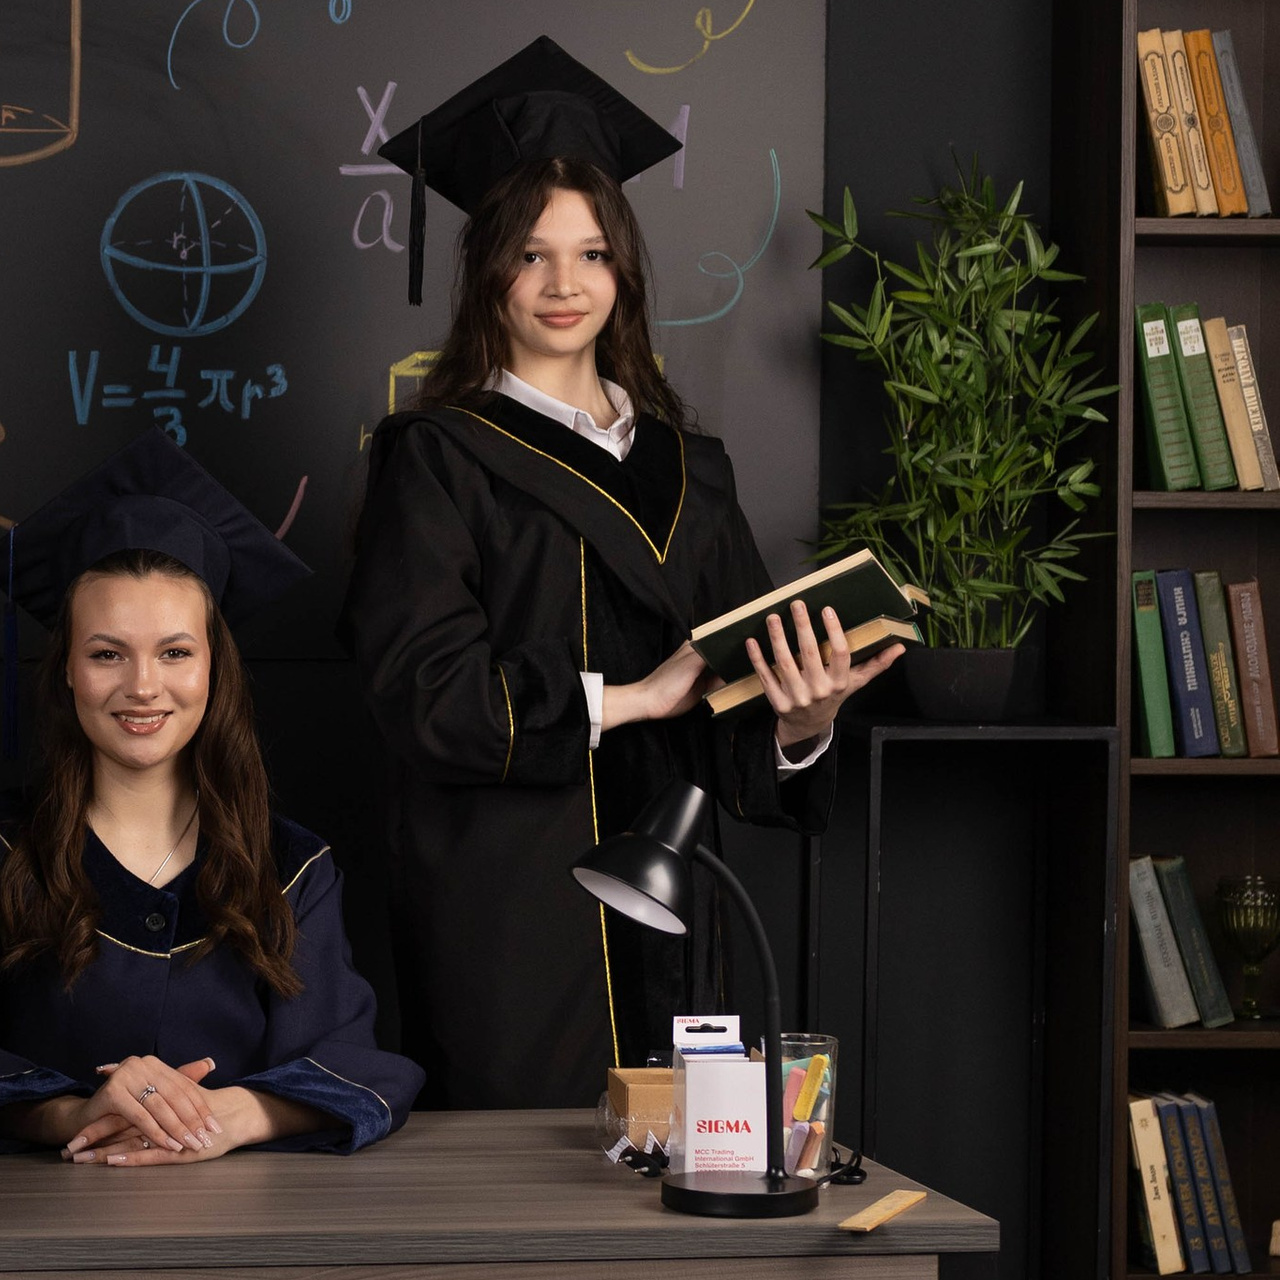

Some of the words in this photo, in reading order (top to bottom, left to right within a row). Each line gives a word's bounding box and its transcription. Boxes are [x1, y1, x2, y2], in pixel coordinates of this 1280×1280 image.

[1232, 338, 1255, 386] НИКОЛАЙ
[1243, 386, 1263, 432] ШМЕЛЕВ
[696, 1119, 752, 1134] SIGMA
